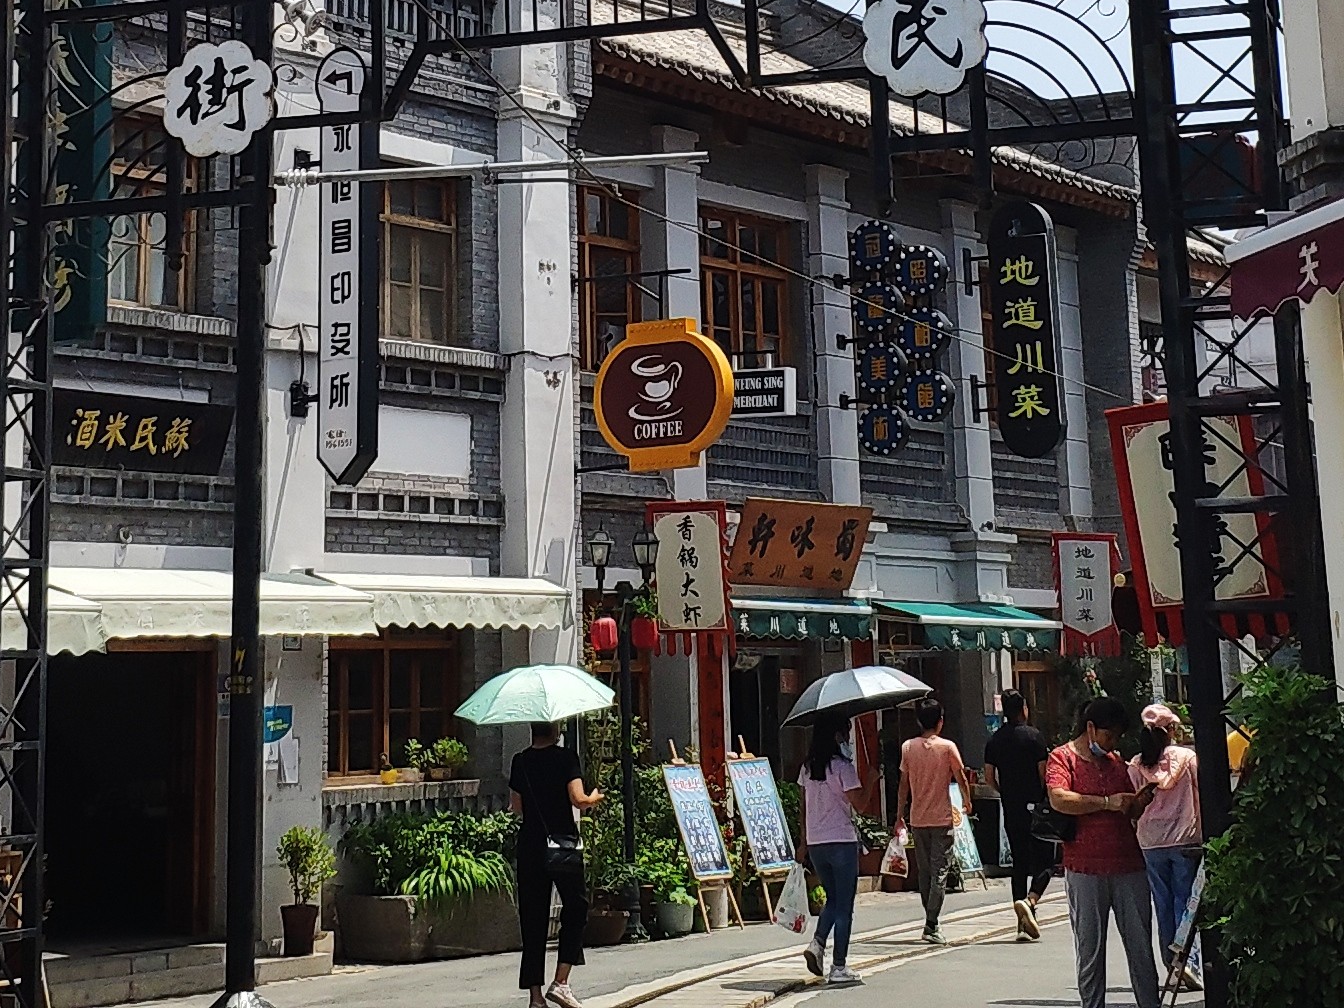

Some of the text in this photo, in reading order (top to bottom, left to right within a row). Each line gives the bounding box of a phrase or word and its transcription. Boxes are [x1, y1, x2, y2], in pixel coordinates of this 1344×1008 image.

[176, 57, 254, 130] 街
[999, 254, 1051, 419] 地道川菜
[733, 394, 779, 409] MERCHANT
[763, 375, 784, 390] SING
[634, 420, 683, 440] COFFEE
[675, 514, 703, 628] 香锅大虾
[1074, 545, 1096, 623] 地道川菜
